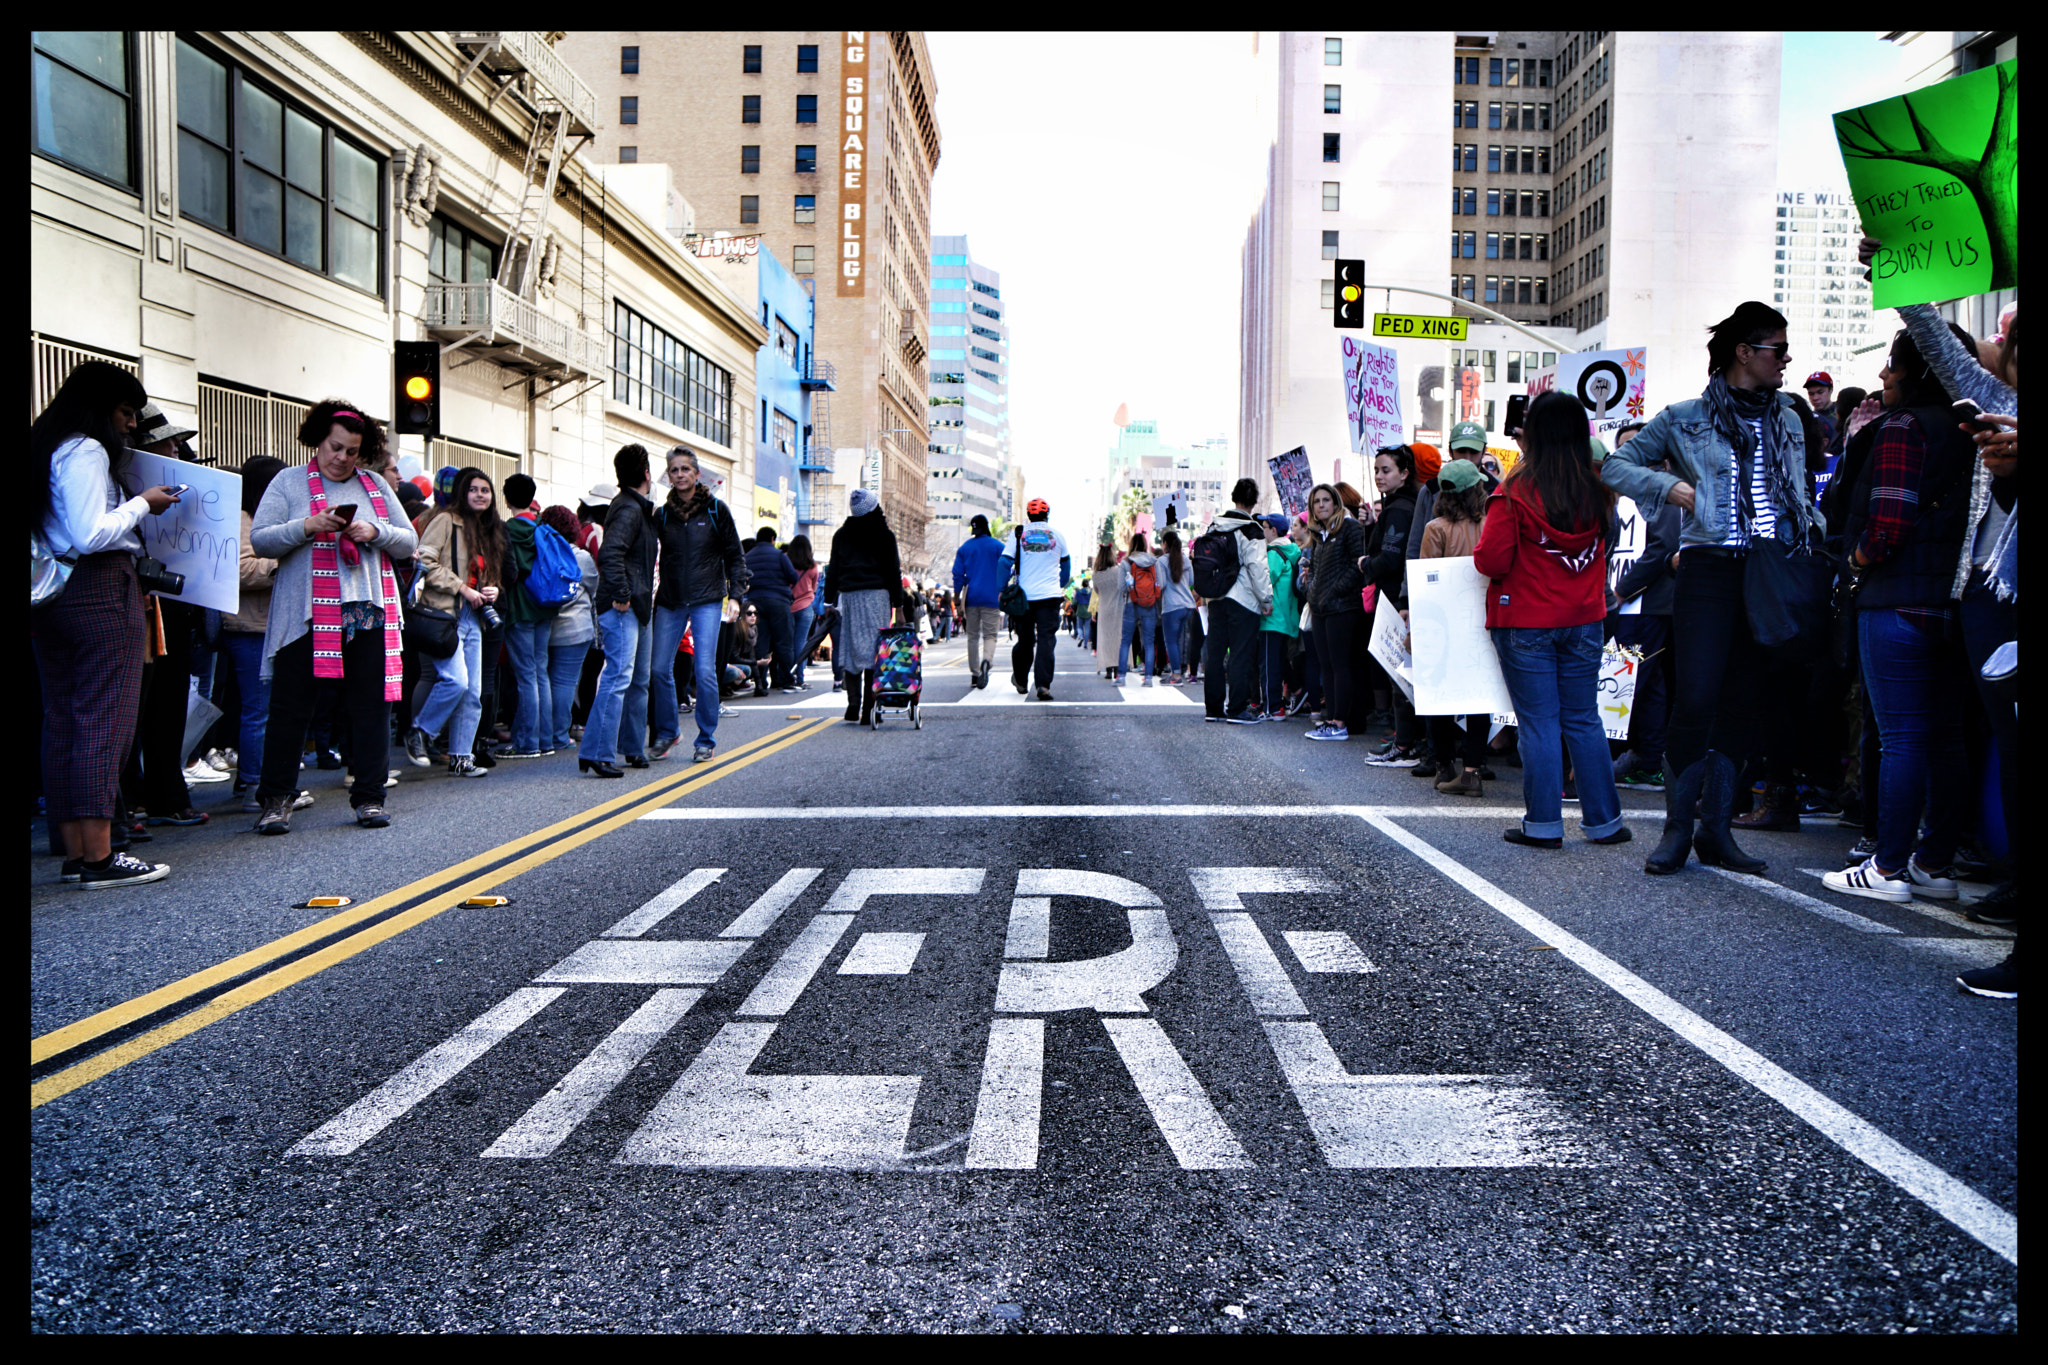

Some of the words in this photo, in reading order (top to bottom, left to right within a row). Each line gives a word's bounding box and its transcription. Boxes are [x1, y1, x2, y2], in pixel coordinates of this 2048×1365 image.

[843, 77, 864, 189] SQUARE
[1861, 189, 1909, 216] THEY
[1912, 182, 1963, 207] TRIED
[843, 203, 861, 286] BLDG.
[1877, 240, 1933, 280] BURY
[1946, 236, 1979, 268] US
[1381, 317, 1414, 334] PED
[1421, 320, 1460, 336] XING
[1366, 346, 1396, 375] Rights
[1381, 374, 1395, 390] for
[1527, 373, 1555, 397] MAKE
[1348, 411, 1360, 424] an
[1391, 423, 1404, 434] are
[1598, 418, 1633, 433] FORGET
[1367, 432, 1385, 448] WE
[283, 866, 1606, 1173] HERE
